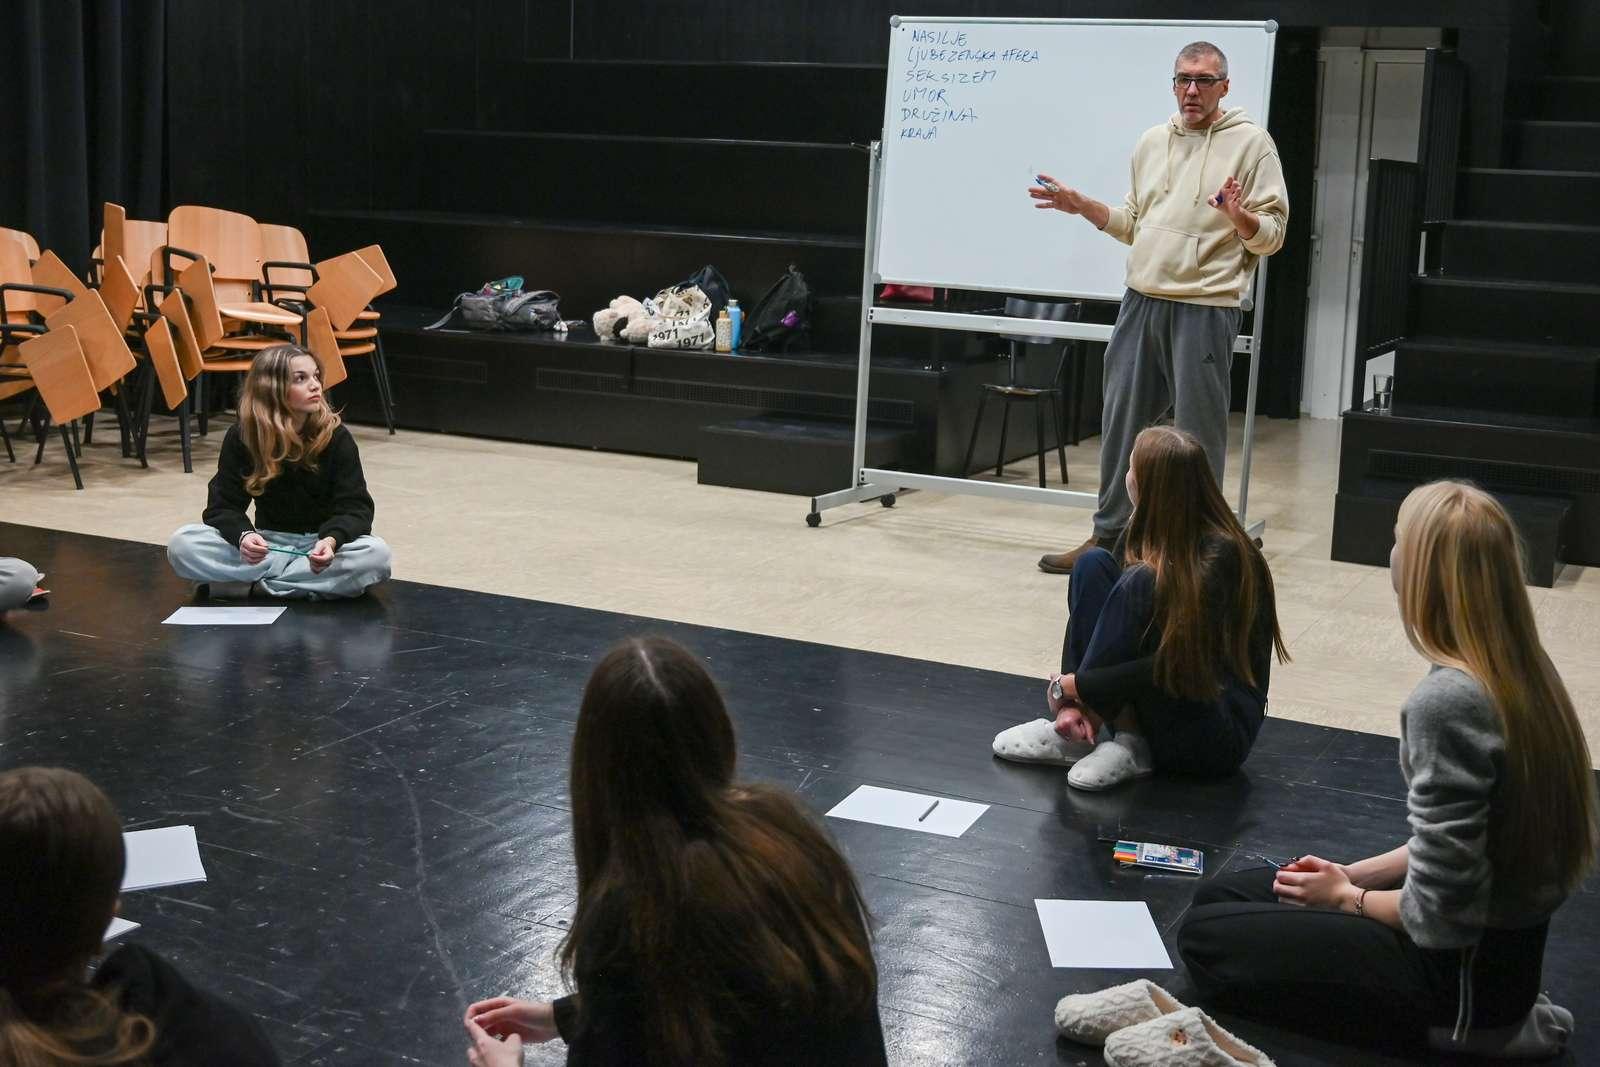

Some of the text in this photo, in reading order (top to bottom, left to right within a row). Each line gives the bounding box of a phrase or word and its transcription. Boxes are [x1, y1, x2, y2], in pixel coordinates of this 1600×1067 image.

[911, 29, 967, 46] NASILJE
[1001, 48, 1040, 63] AFERA
[905, 69, 997, 84] SEKSIZEM
[902, 87, 949, 106] UMOR
[900, 107, 978, 123] DRUŽINA
[900, 126, 937, 140] KRAJA
[677, 332, 704, 348] 1971
